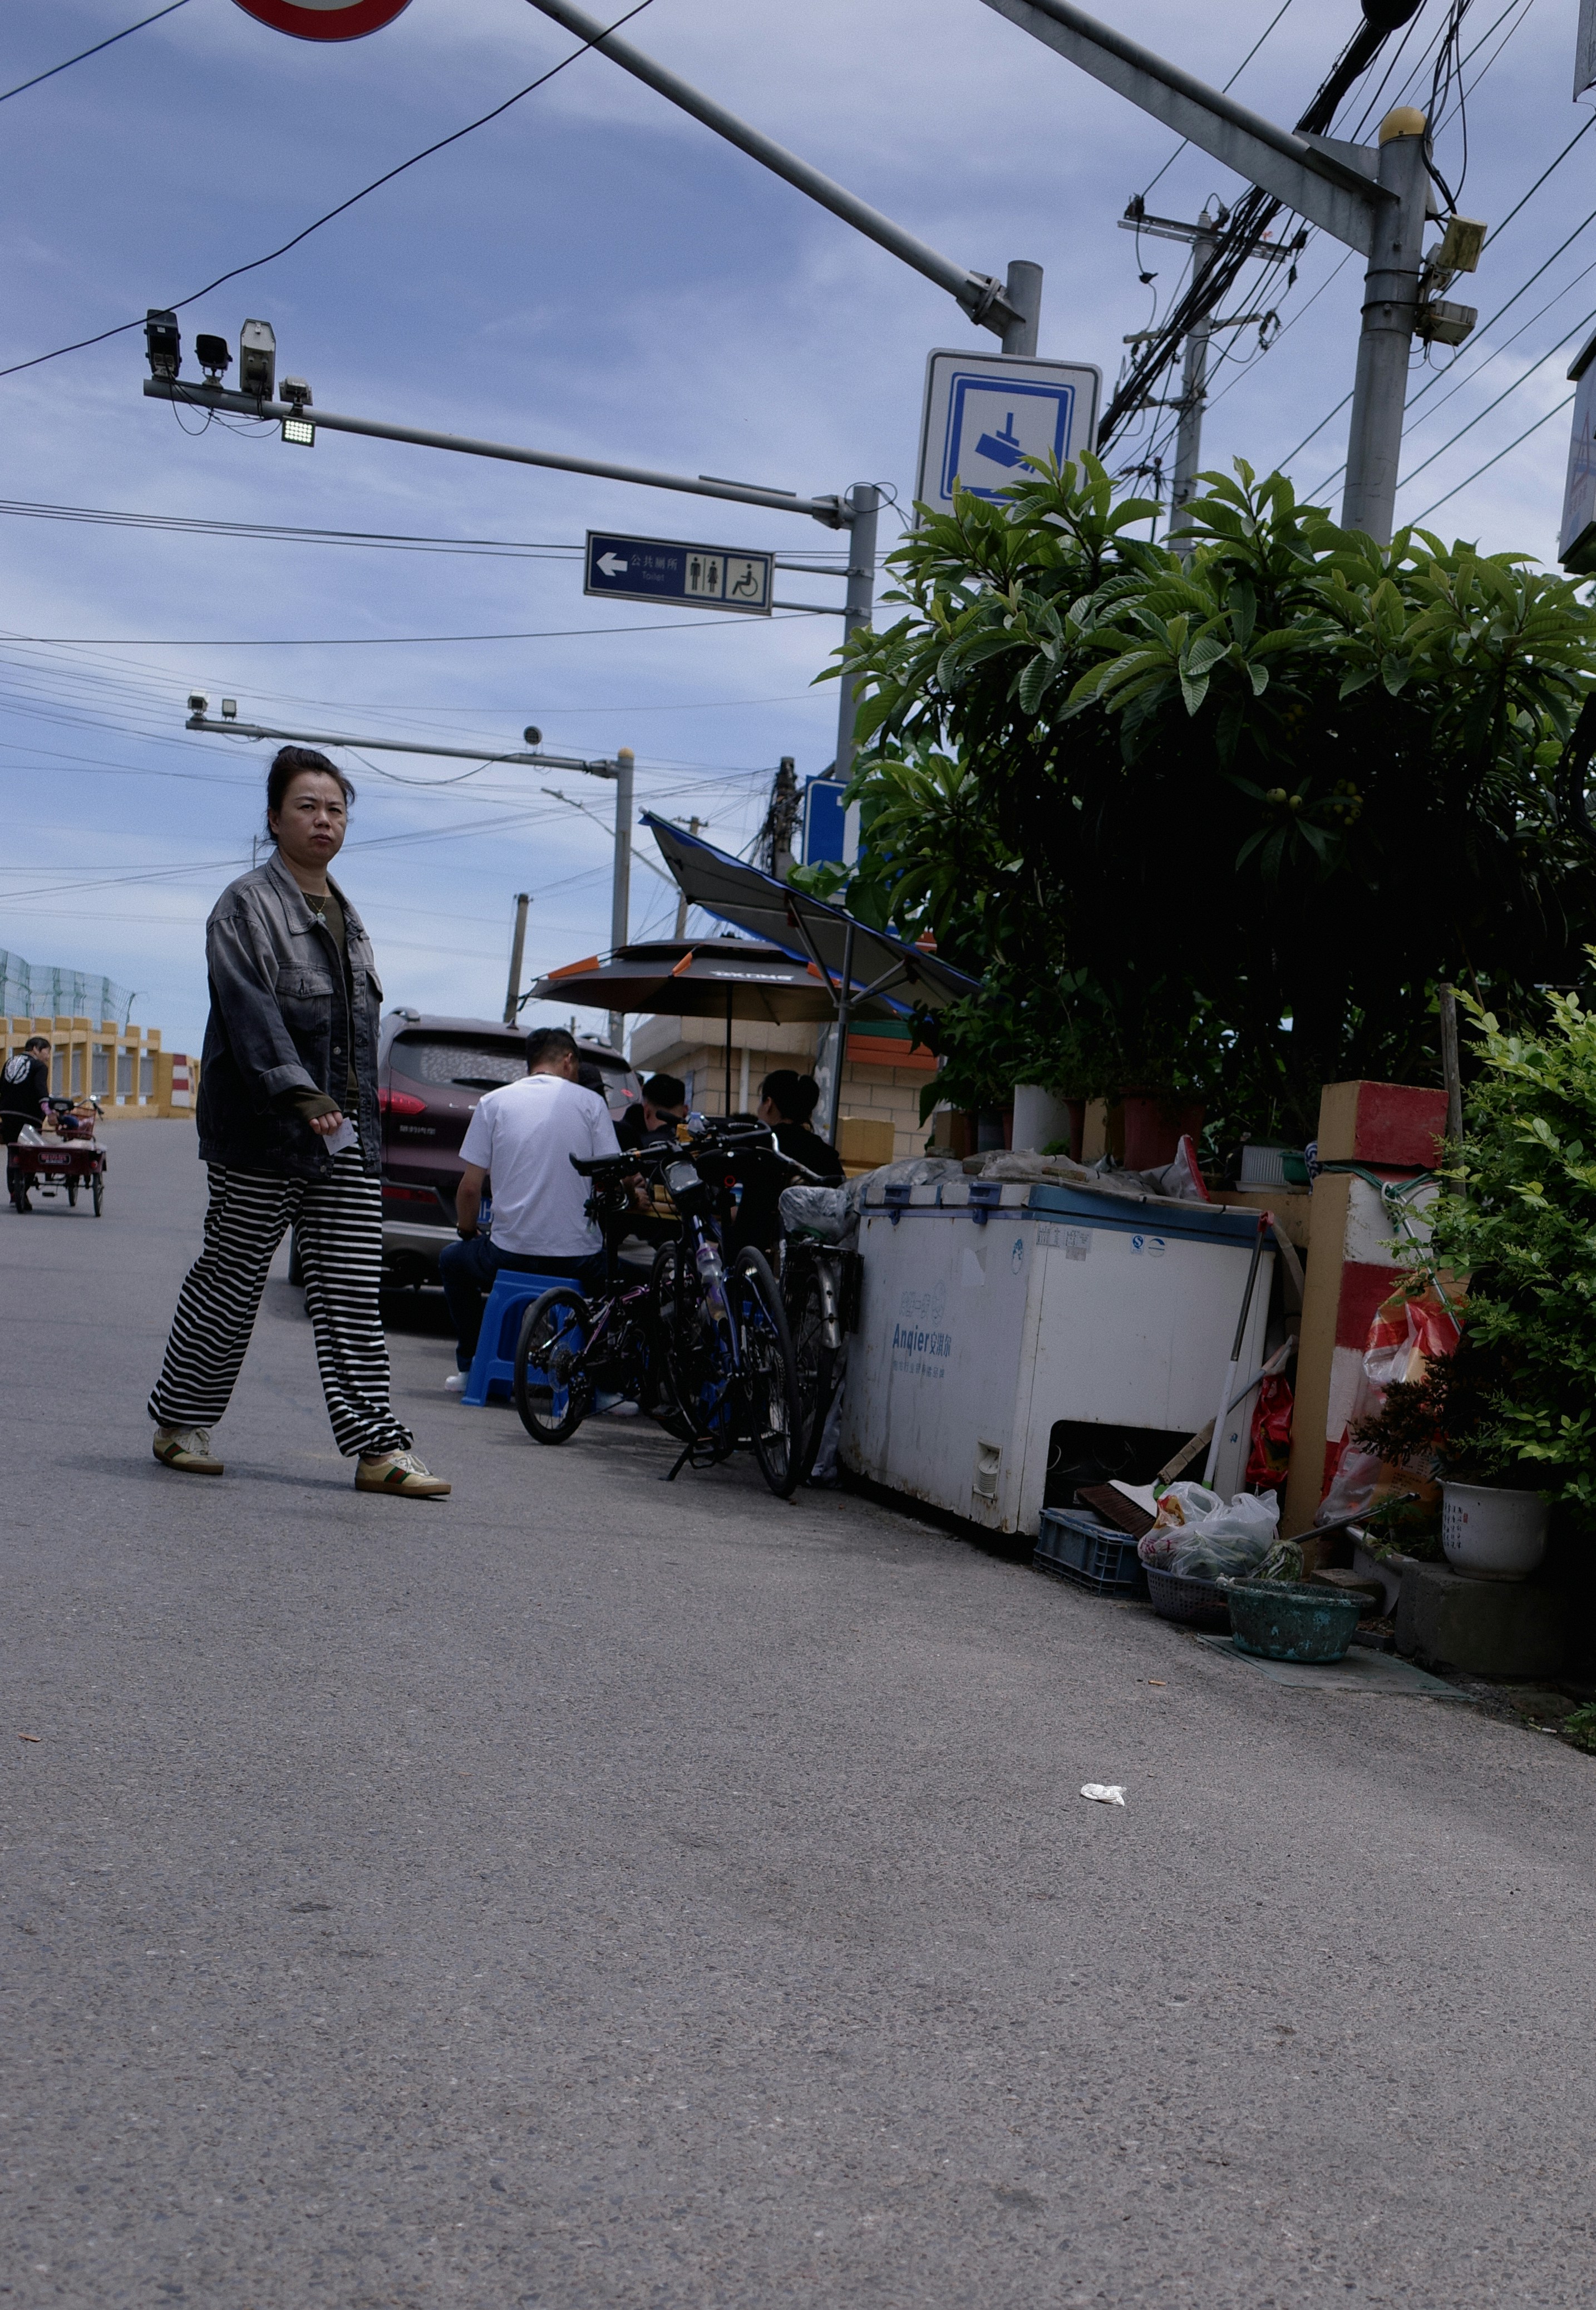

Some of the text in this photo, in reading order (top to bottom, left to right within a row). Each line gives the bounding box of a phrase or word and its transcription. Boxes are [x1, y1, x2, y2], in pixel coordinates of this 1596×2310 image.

[642, 570, 664, 582] Toilet
[893, 1323, 952, 1357] Anqier 安淇尔
